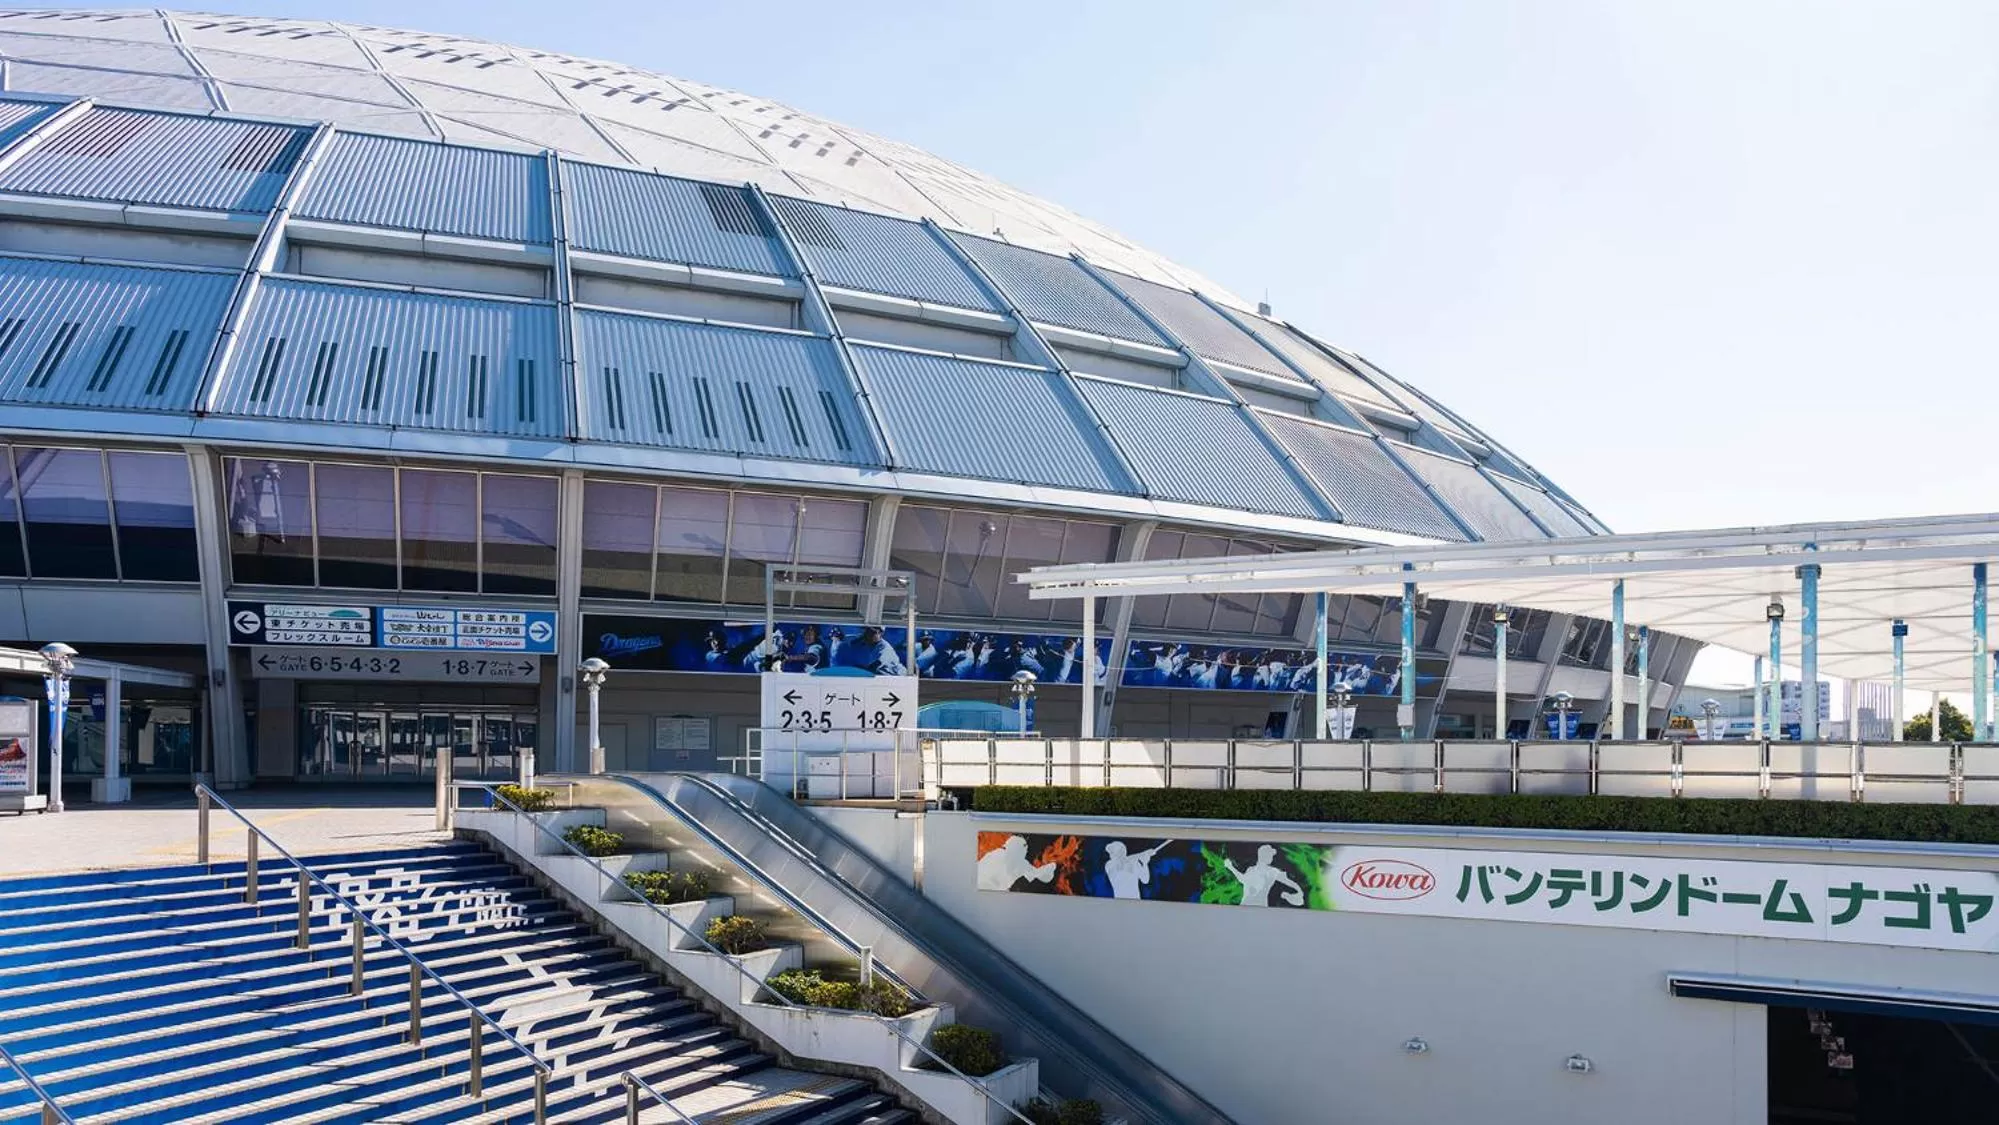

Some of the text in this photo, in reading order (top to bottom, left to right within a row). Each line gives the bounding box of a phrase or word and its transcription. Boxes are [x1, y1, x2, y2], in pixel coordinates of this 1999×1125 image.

[599, 632, 664, 653] Dragons
[279, 663, 308, 672] GATE
[824, 692, 862, 706] ゲート
[1349, 866, 1431, 890] Kowa
[1456, 864, 1995, 934] バンテリンドーム ナゴヤ
